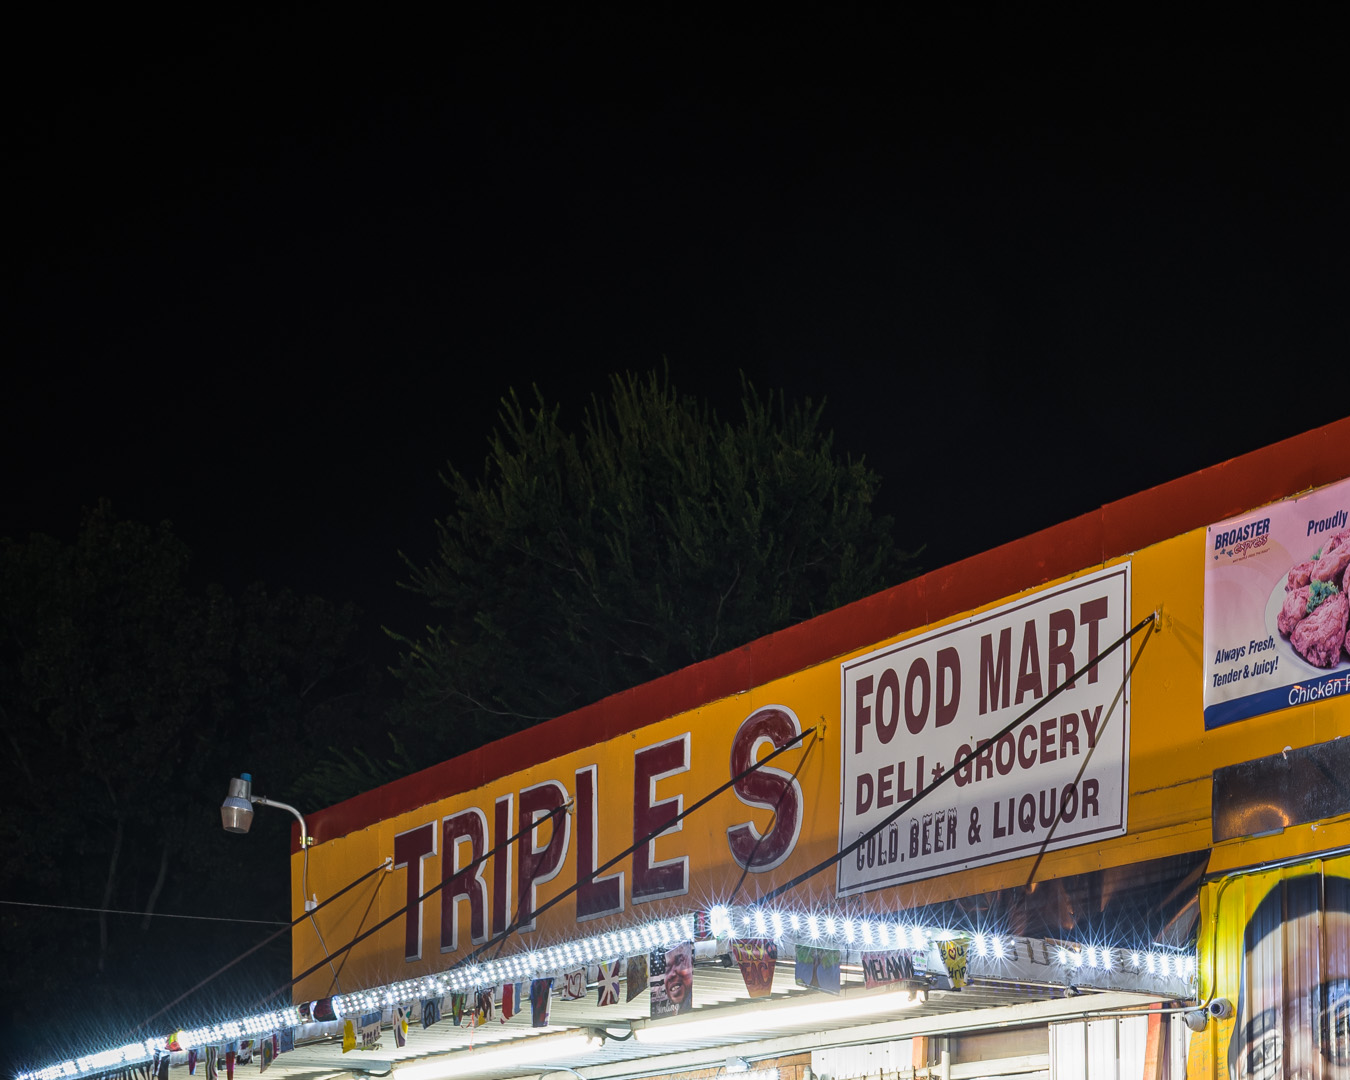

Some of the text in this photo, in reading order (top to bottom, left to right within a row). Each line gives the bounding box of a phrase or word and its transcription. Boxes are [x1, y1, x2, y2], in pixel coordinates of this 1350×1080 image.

[1215, 518, 1271, 550] BROASTER
[1307, 510, 1348, 537] Proudly
[1215, 635, 1277, 665] Always Fresh,
[855, 596, 1108, 755] FOOD MART
[1213, 656, 1279, 688] Tender & Juicy!
[1288, 680, 1342, 706] Chicken
[856, 705, 1104, 816] DELI GROCERY
[394, 704, 803, 963] TRIPLE S
[909, 808, 958, 860] BEER
[968, 806, 982, 846] &
[993, 778, 1100, 839] LIQUOR
